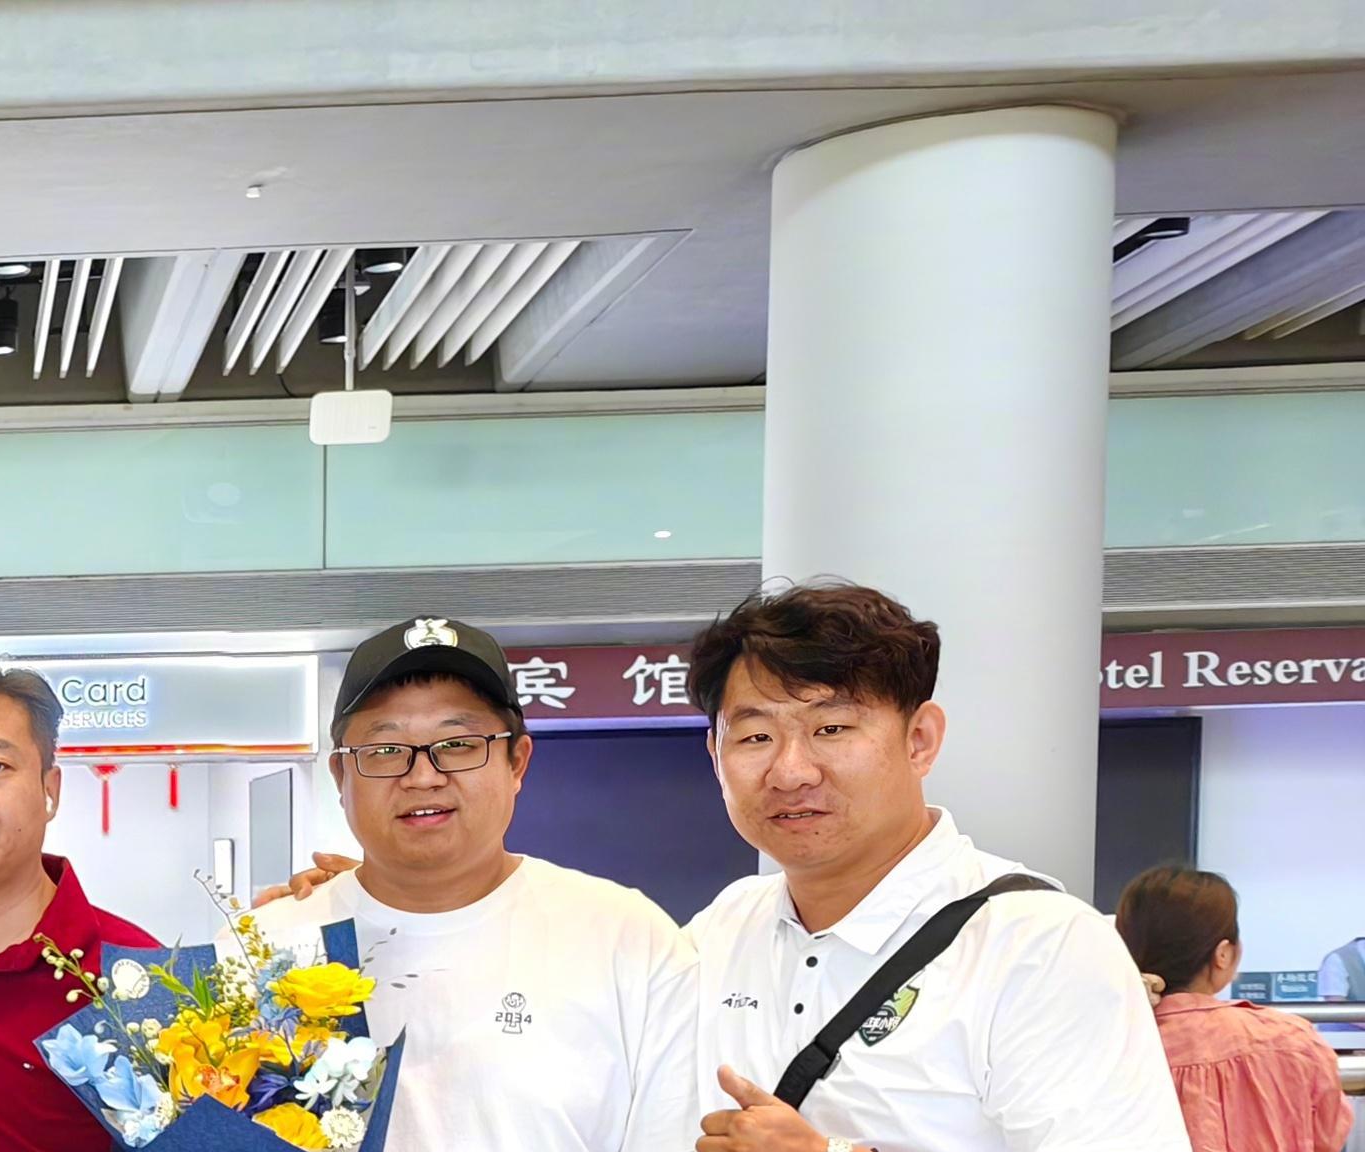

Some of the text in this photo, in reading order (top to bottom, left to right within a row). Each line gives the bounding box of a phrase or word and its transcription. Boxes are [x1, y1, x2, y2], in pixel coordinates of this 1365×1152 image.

[508, 655, 691, 710] 宾馆
[1099, 651, 1165, 689] tel
[61, 677, 146, 703] Card
